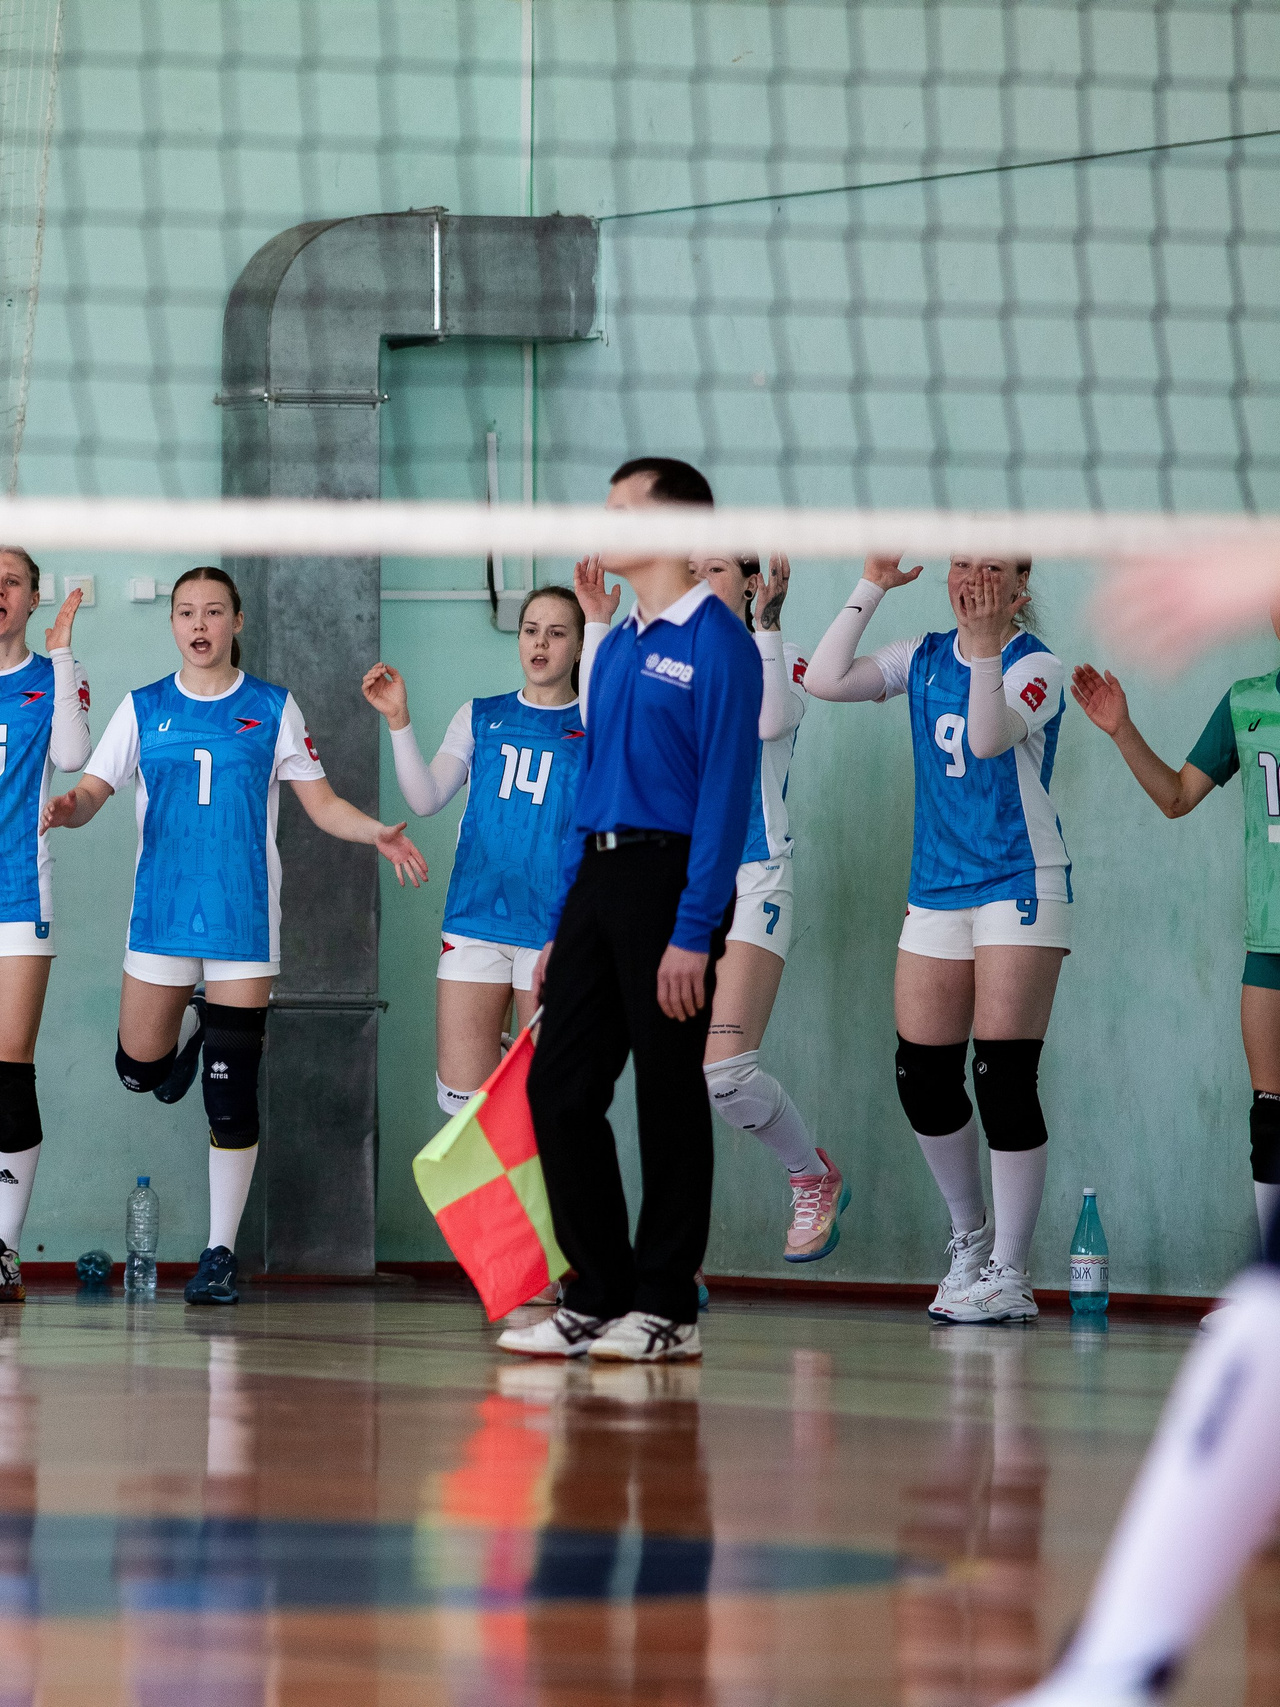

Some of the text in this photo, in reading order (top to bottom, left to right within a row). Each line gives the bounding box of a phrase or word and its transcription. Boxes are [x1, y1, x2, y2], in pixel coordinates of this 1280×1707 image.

[497, 742, 555, 806] 14
[934, 712, 967, 779] 9
[192, 748, 213, 806] 1
[1258, 751, 1280, 817] 1
[763, 901, 781, 935] 7
[1015, 899, 1039, 926] 9
